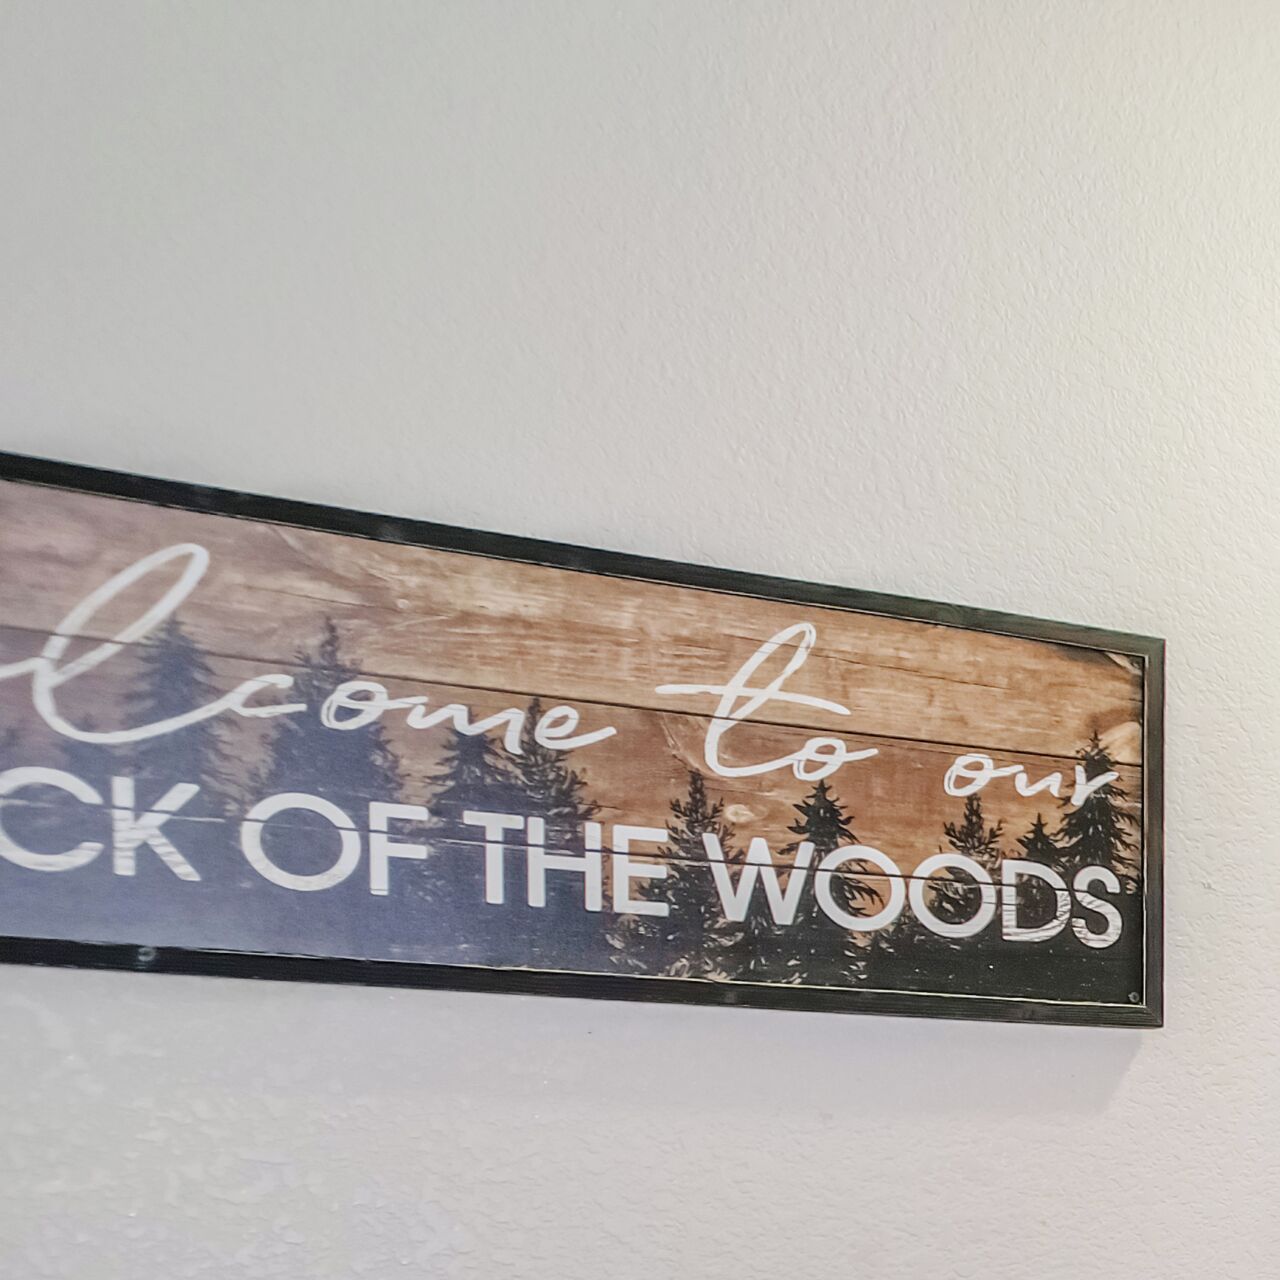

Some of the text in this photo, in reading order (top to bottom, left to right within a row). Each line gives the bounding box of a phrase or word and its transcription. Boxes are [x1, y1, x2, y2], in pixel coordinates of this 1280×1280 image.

[0, 542, 1120, 807] lcome to our
[0, 766, 1123, 949] CK OF THE WOODS
